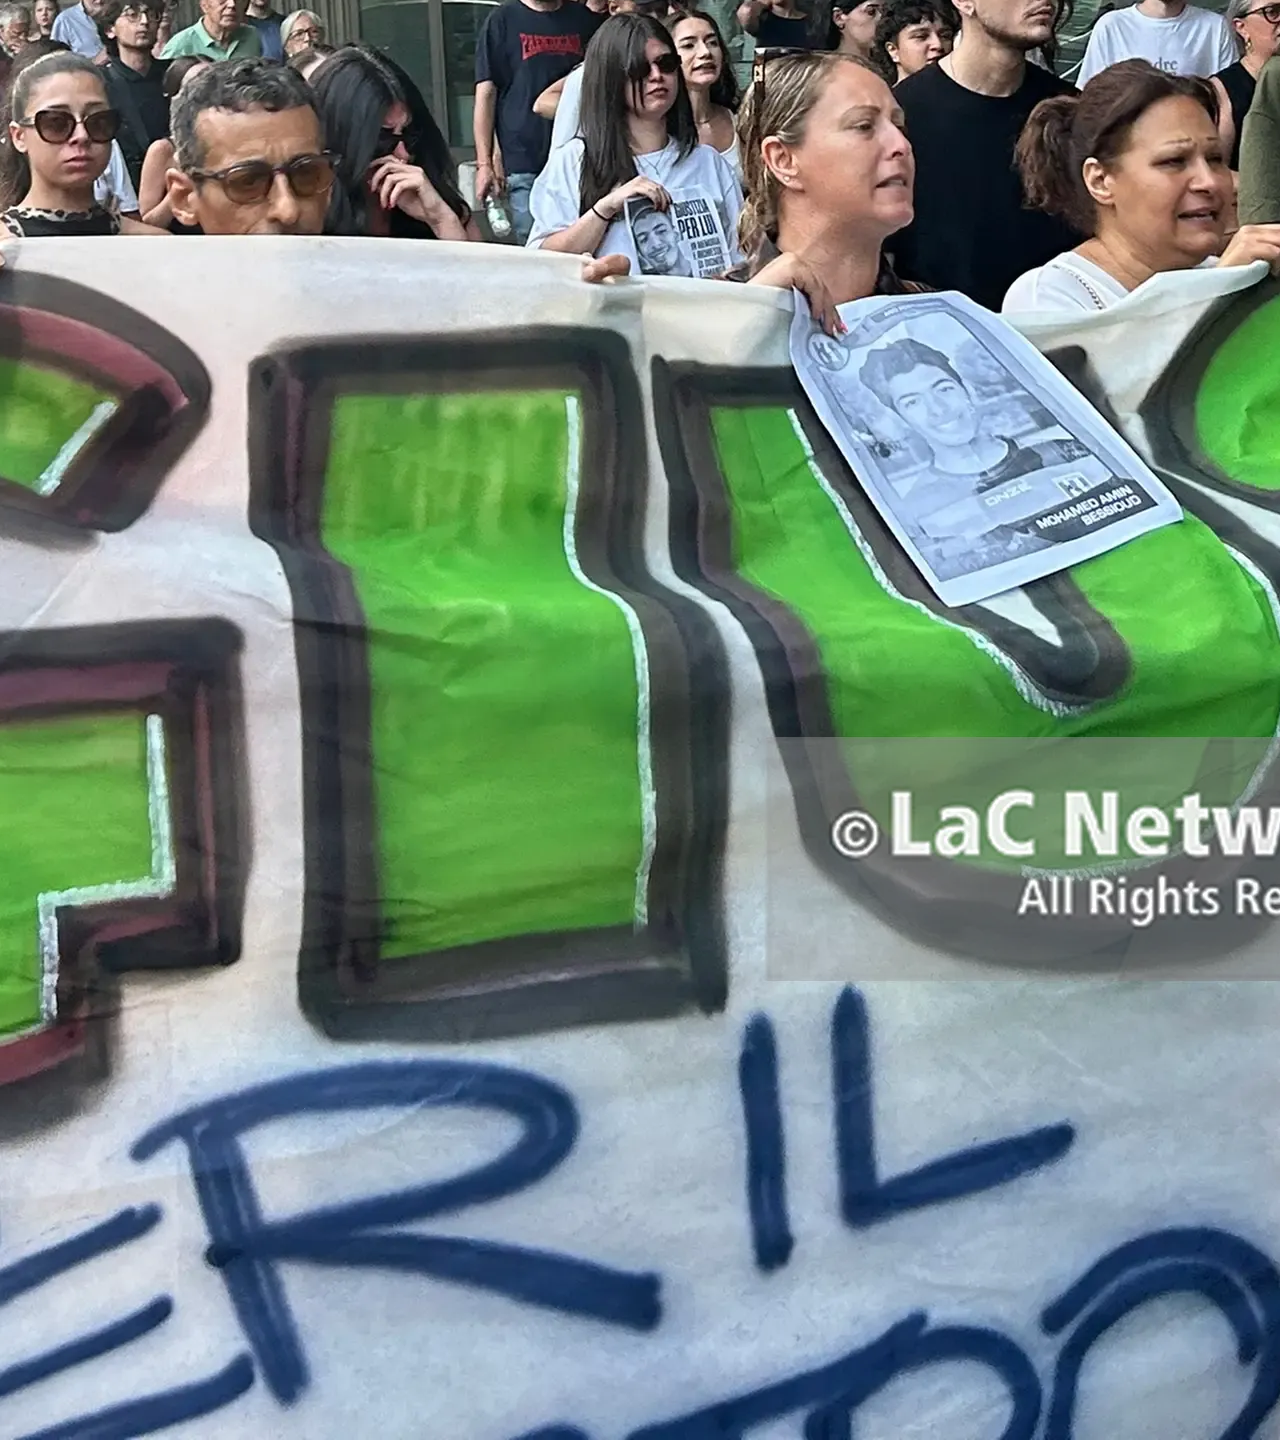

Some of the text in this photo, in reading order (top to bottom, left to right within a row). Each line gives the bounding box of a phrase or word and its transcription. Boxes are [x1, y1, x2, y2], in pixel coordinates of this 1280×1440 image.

[676, 213, 719, 241] PER LUI
[1035, 483, 1134, 530] MOHAMED AMIN
[1080, 494, 1142, 526] BESSIOUD
[738, 982, 1077, 1273] IL
